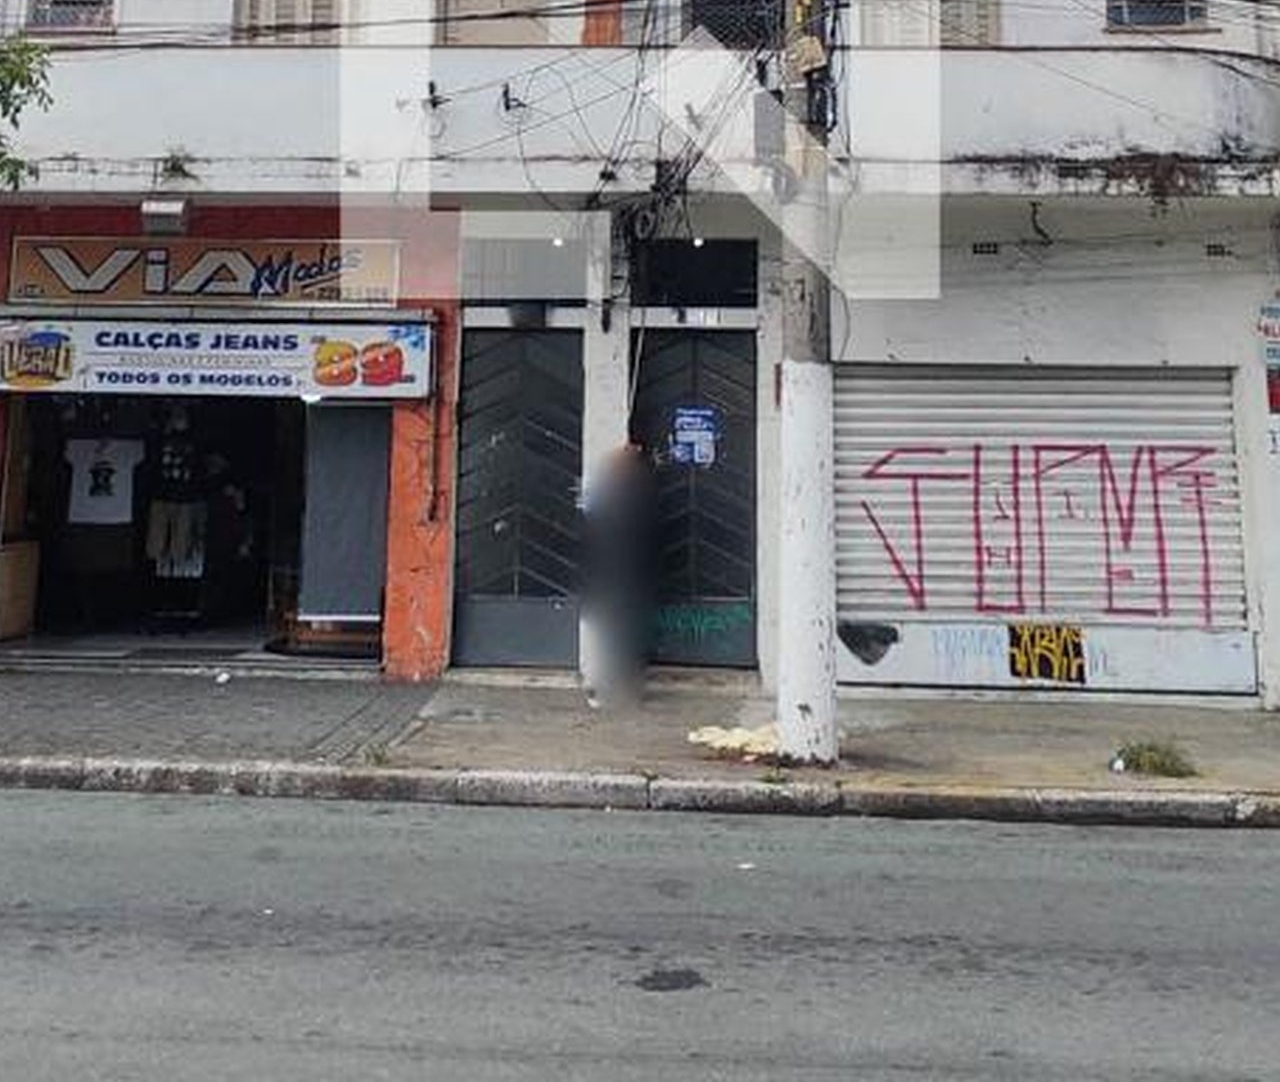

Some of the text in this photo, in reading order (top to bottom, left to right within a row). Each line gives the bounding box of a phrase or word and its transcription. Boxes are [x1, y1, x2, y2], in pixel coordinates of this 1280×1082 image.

[94, 331, 201, 351] CALÇAS
[209, 333, 299, 350] JEANS
[94, 370, 294, 387] TODOS OS MODELOS
